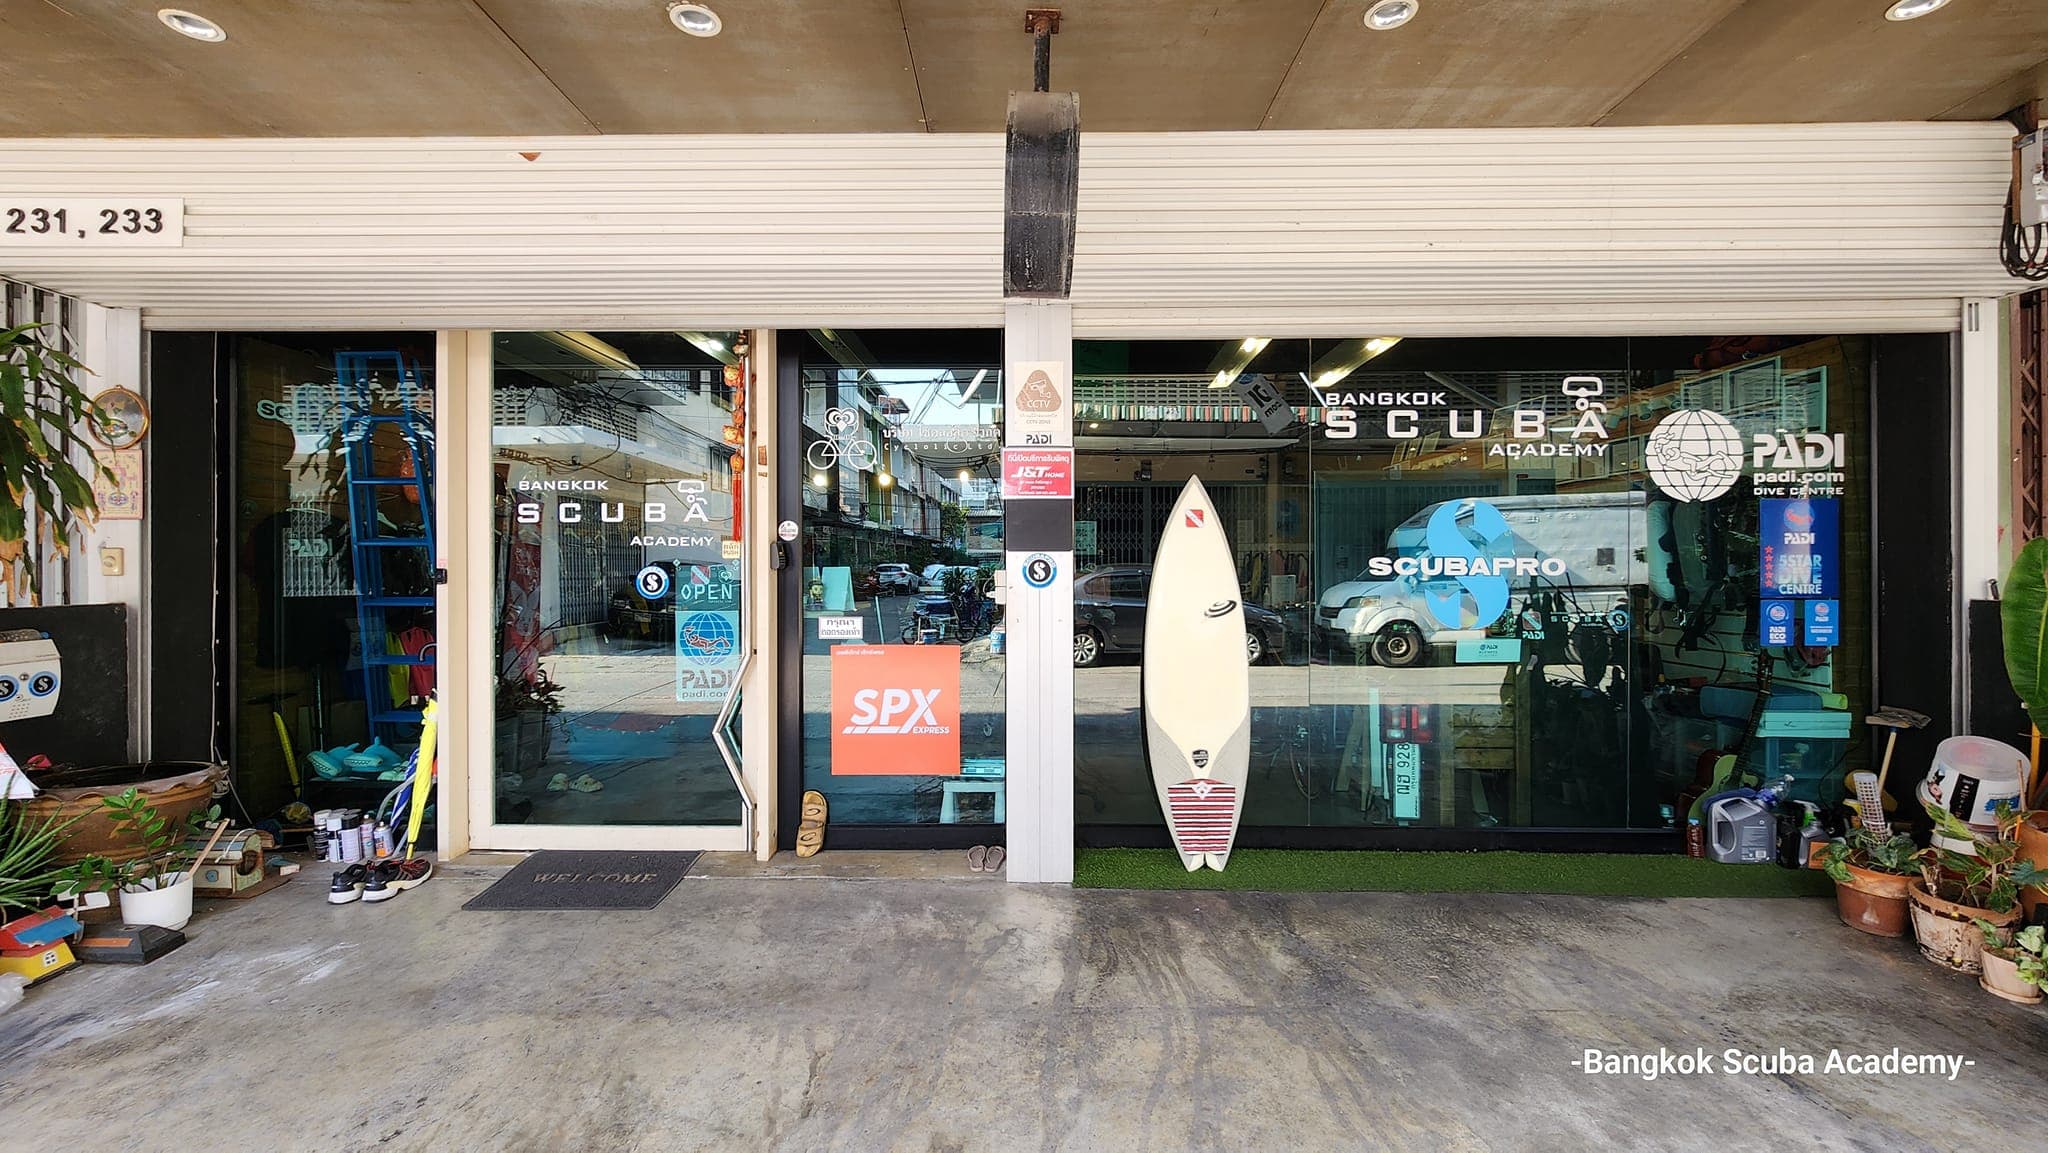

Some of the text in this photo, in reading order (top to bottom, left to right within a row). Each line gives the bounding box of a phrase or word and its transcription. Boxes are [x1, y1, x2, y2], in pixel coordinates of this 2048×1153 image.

[5, 207, 163, 239] 231, 233
[1027, 400, 1050, 408] CCTV
[1326, 392, 1447, 406] BANGKOK
[1325, 410, 1609, 439] SCUBA
[1026, 434, 1052, 444] PADI
[1489, 444, 1609, 457] ACADEMY
[1753, 433, 1845, 468] PADI
[1010, 465, 1052, 478] J&T
[1753, 470, 1845, 485] padi.com
[518, 480, 609, 491] BANGKOK
[1754, 487, 1844, 496] DIVE CENTRE
[517, 502, 709, 523] SCUBA
[630, 536, 714, 547] ACADEMY
[1784, 533, 1815, 544] PADI
[289, 539, 333, 557] PADI
[1368, 557, 1567, 576] SCUBAPRO
[681, 584, 733, 600] OPEN
[1778, 584, 1822, 594] CENTRE
[1522, 631, 1545, 639] PADI
[682, 669, 735, 688] PADI
[850, 688, 941, 726] SPX
[1396, 743, 1410, 769] 928
[532, 872, 657, 884] WELCOME
